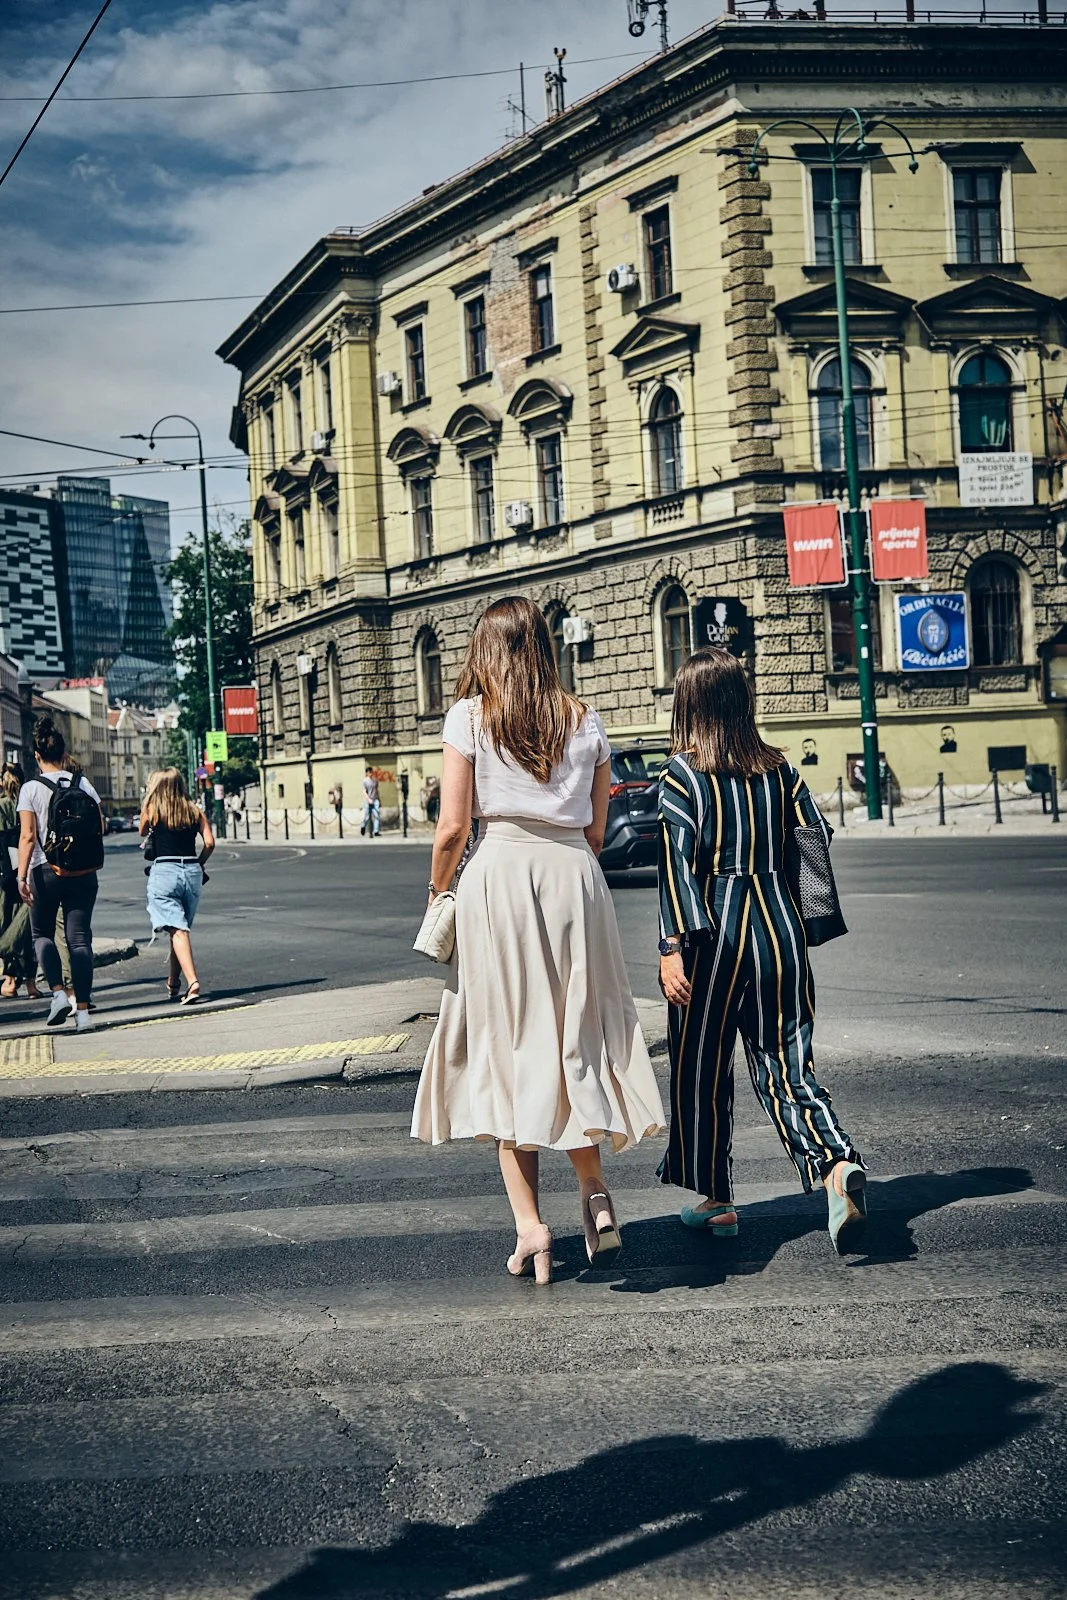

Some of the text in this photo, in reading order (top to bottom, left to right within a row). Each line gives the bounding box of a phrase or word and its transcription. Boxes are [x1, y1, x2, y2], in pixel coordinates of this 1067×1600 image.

[878, 526, 920, 541] prijatelj
[793, 538, 833, 552] wwin
[882, 539, 917, 551] sporta
[900, 596, 966, 617] ORDINACIJA
